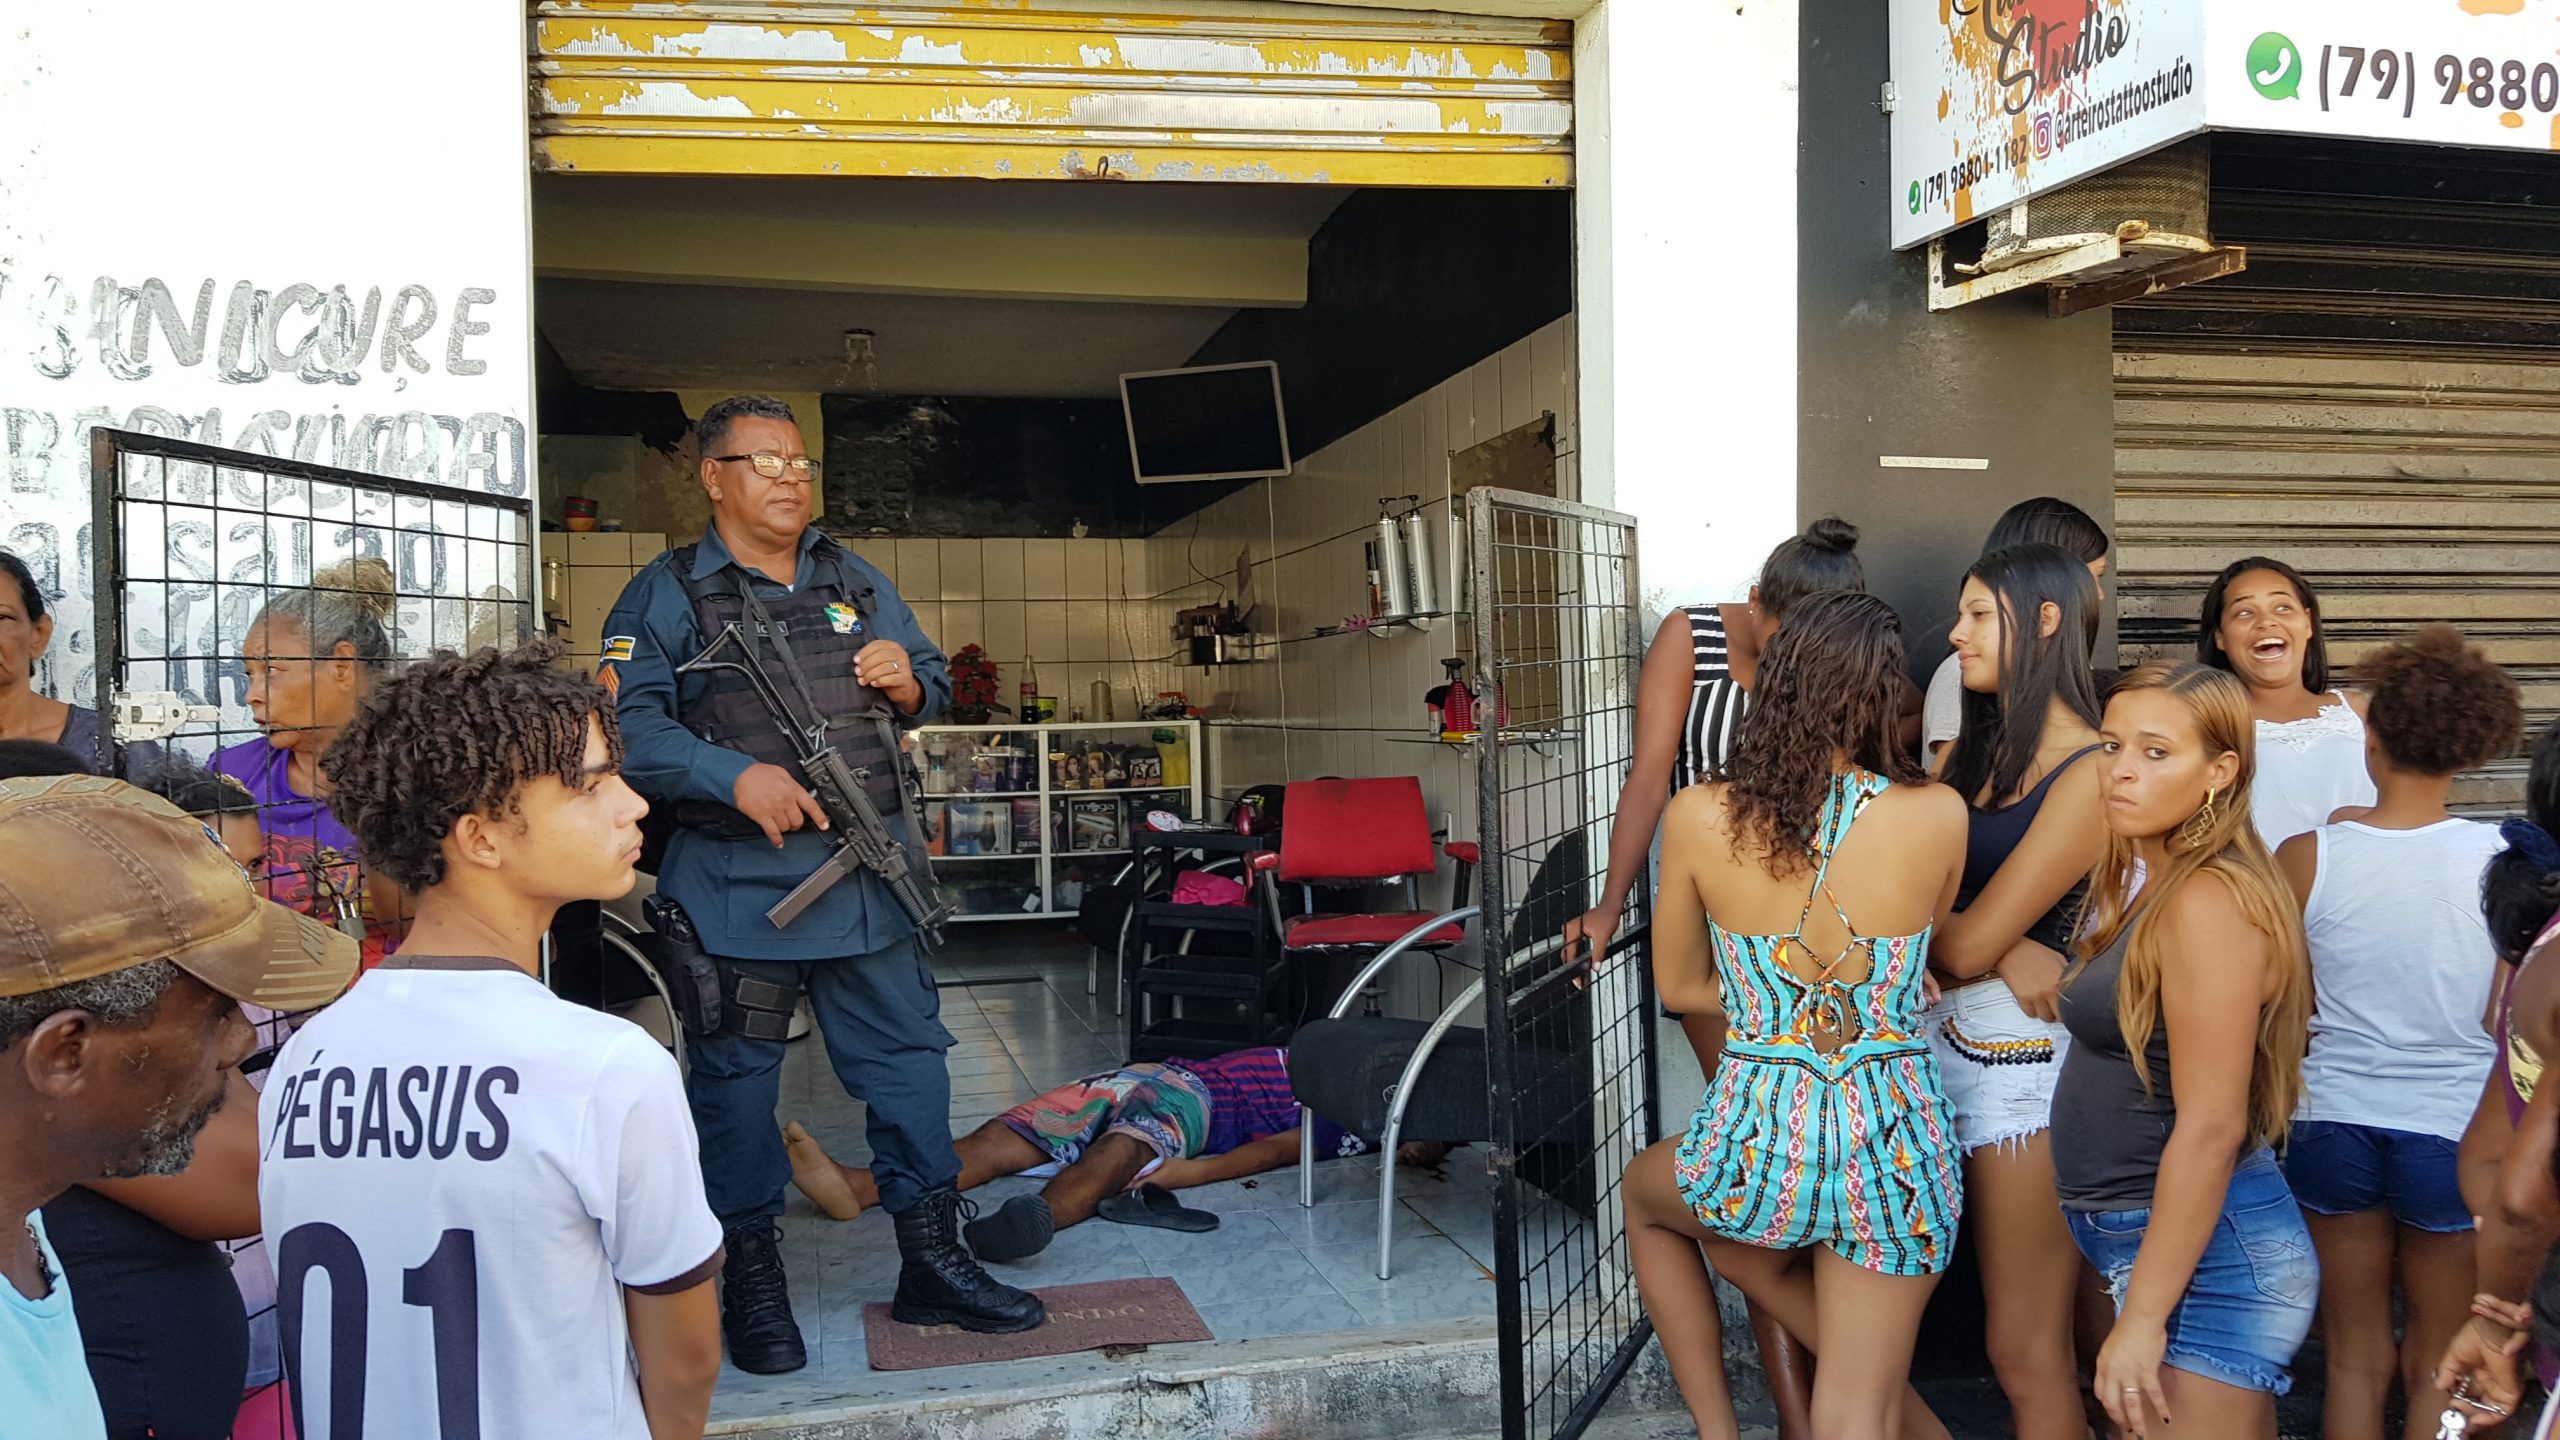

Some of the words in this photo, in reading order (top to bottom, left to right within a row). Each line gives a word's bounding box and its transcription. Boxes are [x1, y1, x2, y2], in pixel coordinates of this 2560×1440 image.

[1998, 0, 2130, 116] Studio
[2319, 44, 2415, 118] (79)
[1924, 170, 1947, 214] (79)
[1951, 134, 2027, 194] 98801-1182
[2055, 55, 2192, 148] @arteirostattoostudio
[1409, 562, 1418, 608] RECOVERY
[263, 1049, 519, 1162] PÉGASUS
[277, 1221, 481, 1440] 01
